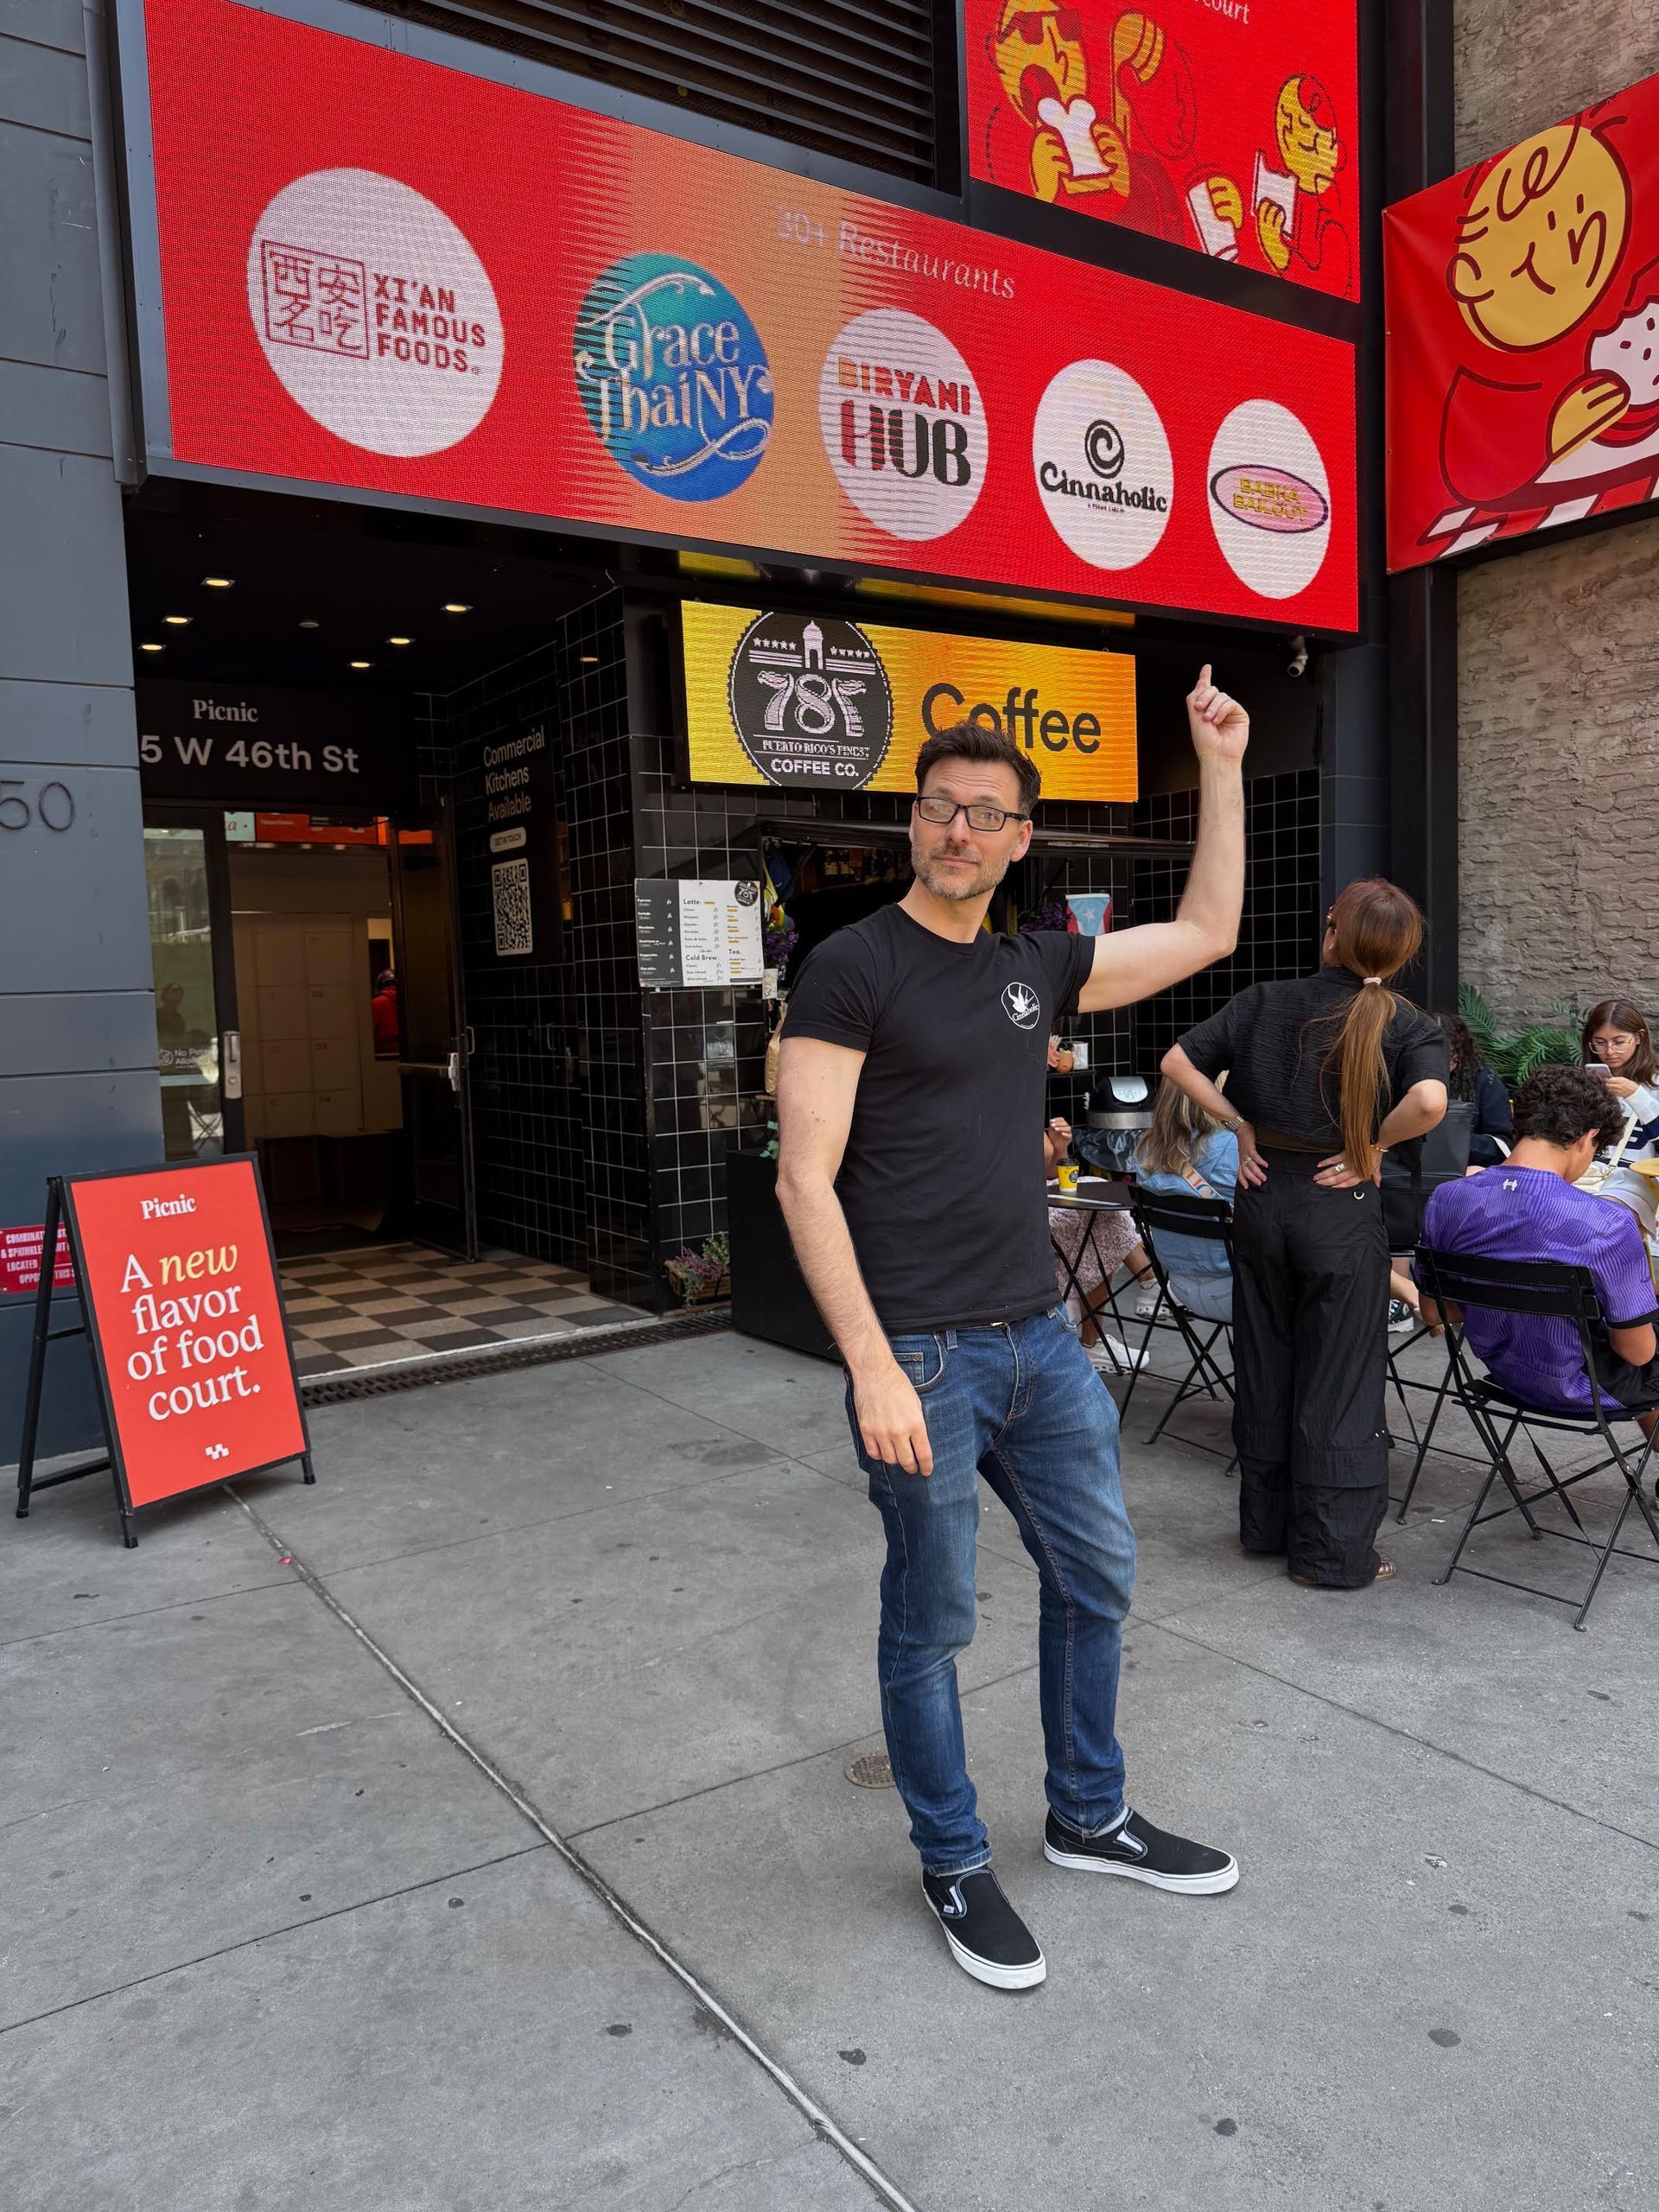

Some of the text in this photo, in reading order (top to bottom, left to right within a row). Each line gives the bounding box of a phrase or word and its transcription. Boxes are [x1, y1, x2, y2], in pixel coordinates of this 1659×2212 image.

[838, 220, 1015, 300] Restaurants
[373, 272, 455, 314] XI'AN
[376, 302, 486, 347] FAMOUS
[603, 302, 741, 380] Grace
[837, 357, 970, 416] BIRYANI
[840, 399, 971, 486] HUB
[1040, 461, 1167, 513] Cinnaholic
[192, 699, 258, 722] Picnic
[922, 683, 1101, 753] Coffee
[140, 734, 359, 772] 5 W 46th St
[483, 724, 545, 767] Commercial
[804, 742, 836, 754] RICO'S
[485, 766, 530, 795] Kitchens
[771, 759, 859, 776] COFFEE CO.
[488, 791, 532, 823] Available
[141, 1193, 196, 1220] Picnic
[6, 1230, 45, 1244] COMBINAT
[8, 1245, 43, 1258] SPRINKLE
[7, 1259, 38, 1272] LOCATED
[120, 1243, 238, 1293] A new
[130, 1285, 242, 1335] flavor
[127, 1314, 264, 1381] of food
[148, 1363, 261, 1421] court.
